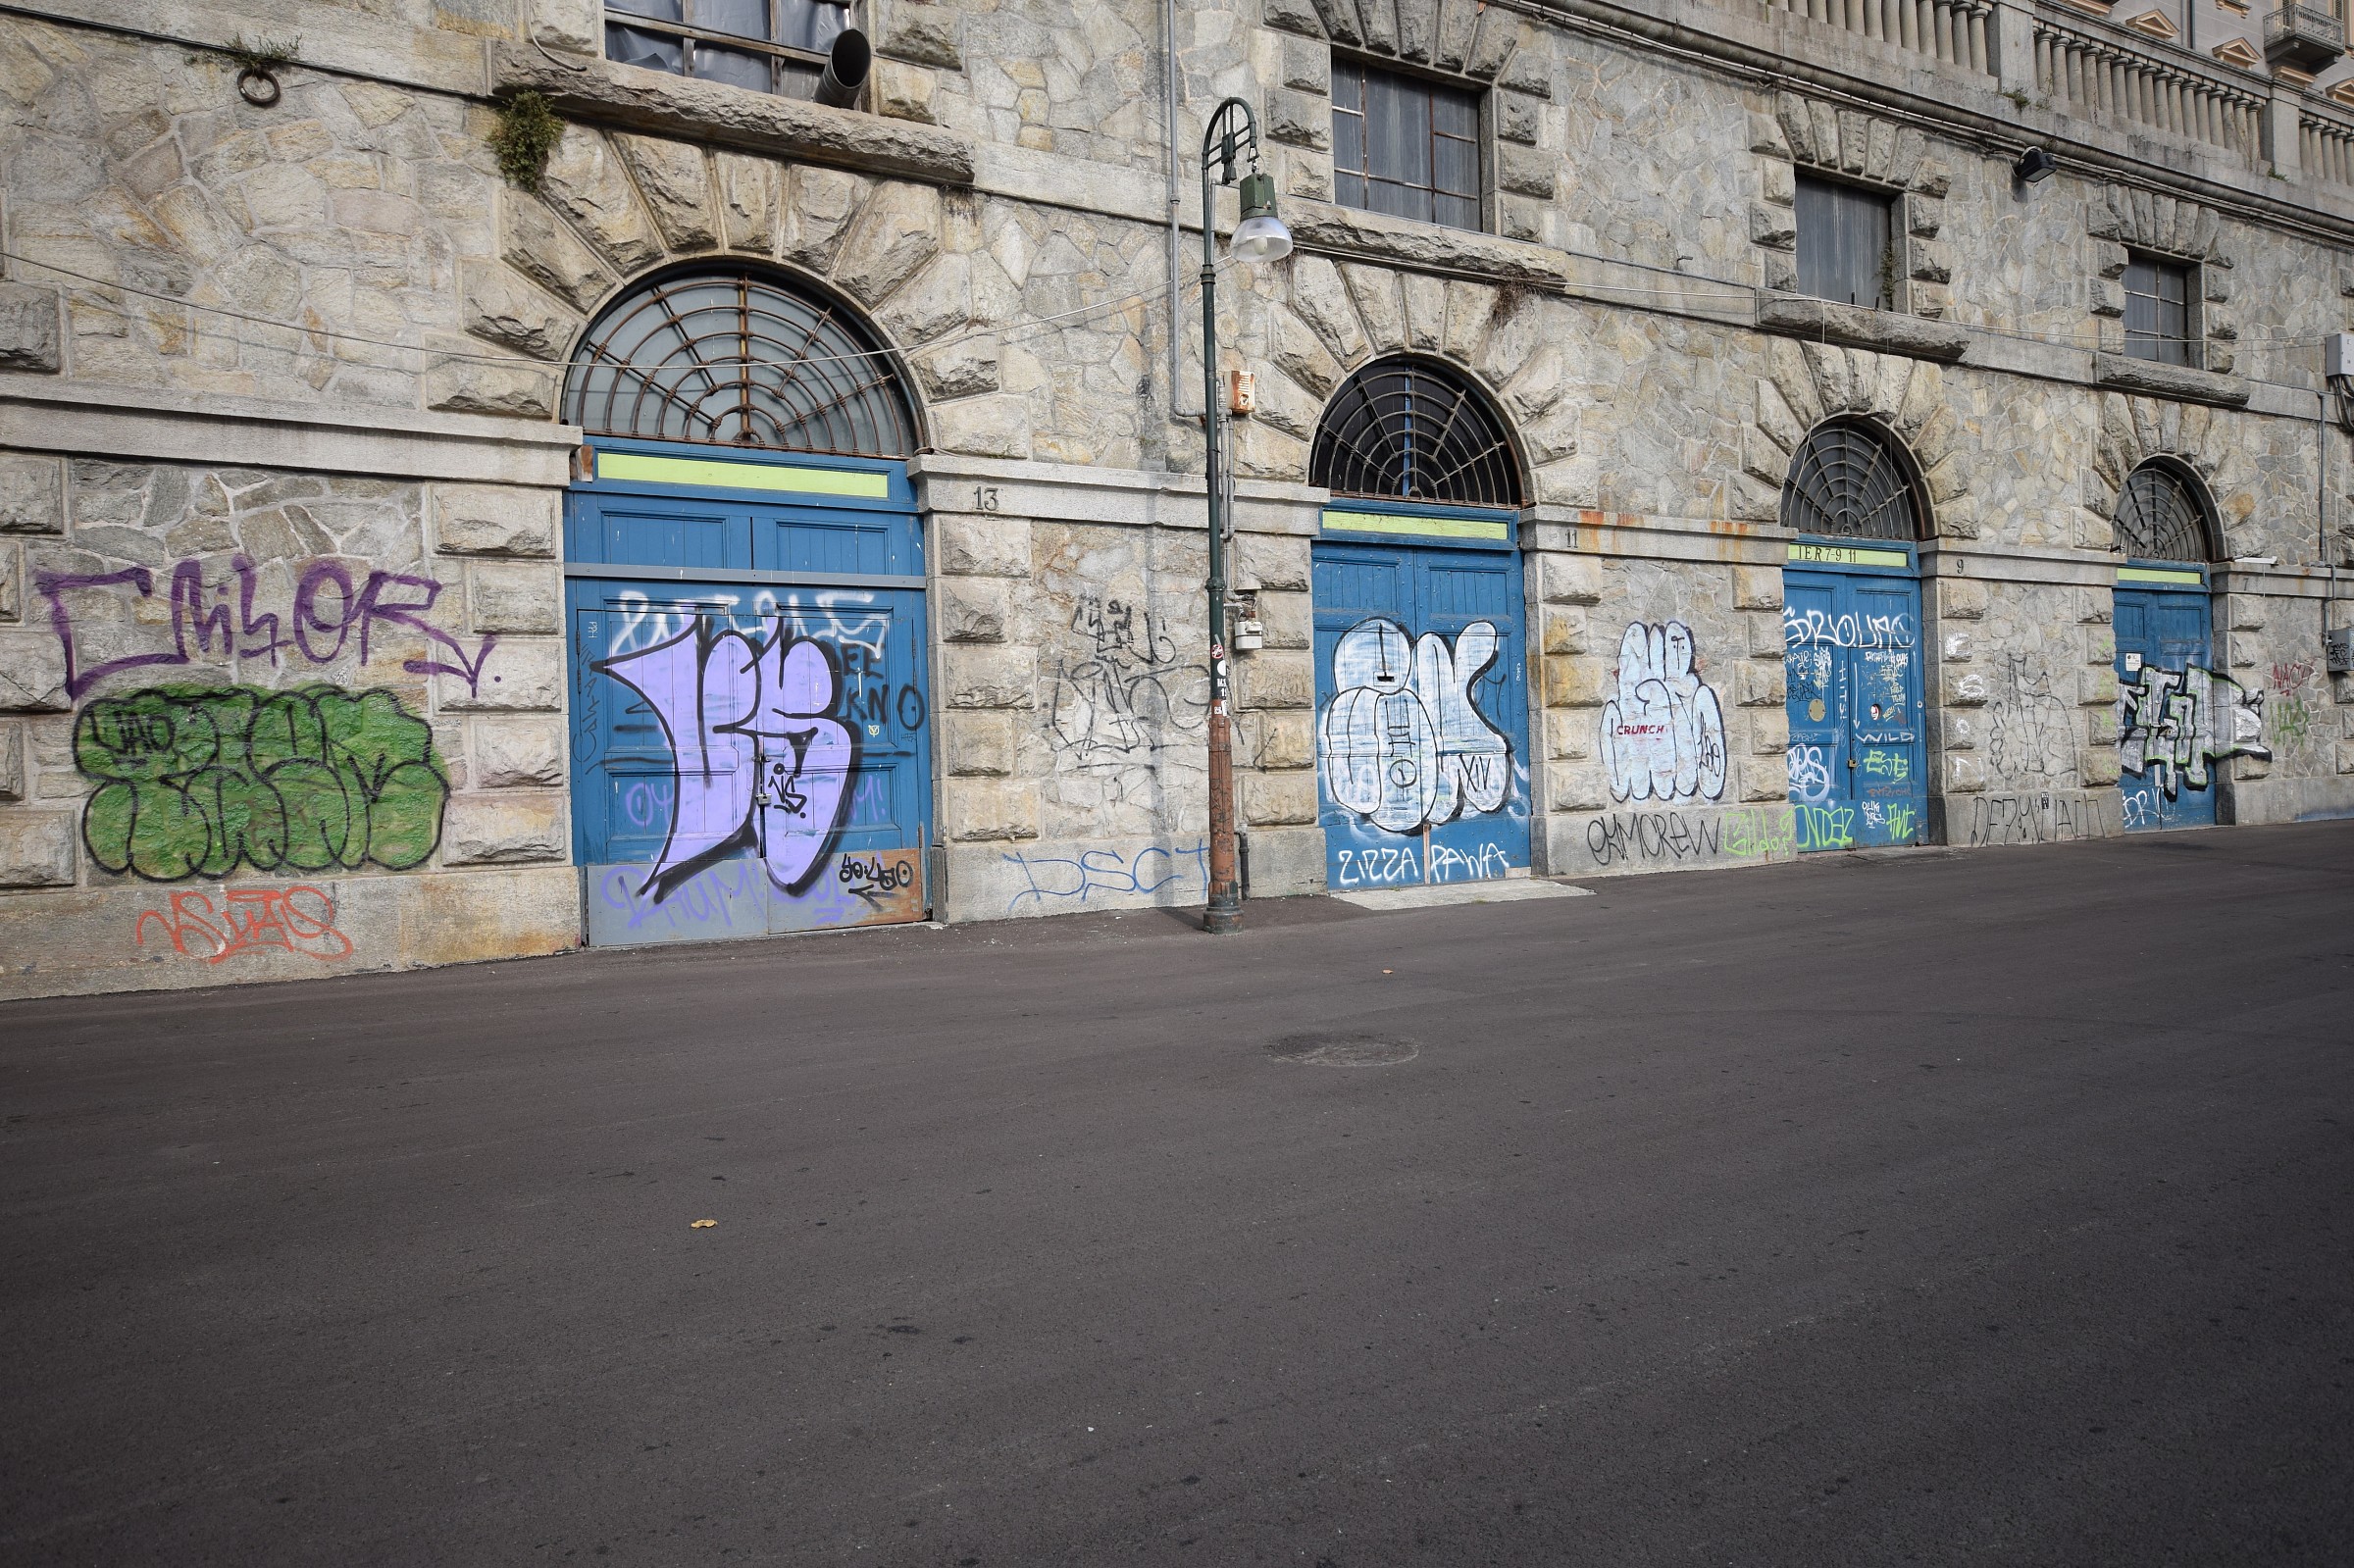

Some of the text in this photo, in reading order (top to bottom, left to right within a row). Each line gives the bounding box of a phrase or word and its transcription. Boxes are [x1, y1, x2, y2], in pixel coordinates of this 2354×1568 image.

[973, 485, 999, 511] 13
[1564, 530, 1578, 548] 11
[1956, 558, 1965, 575] 9
[1616, 725, 1664, 735] CRUNCH
[1855, 733, 1916, 743] WILD
